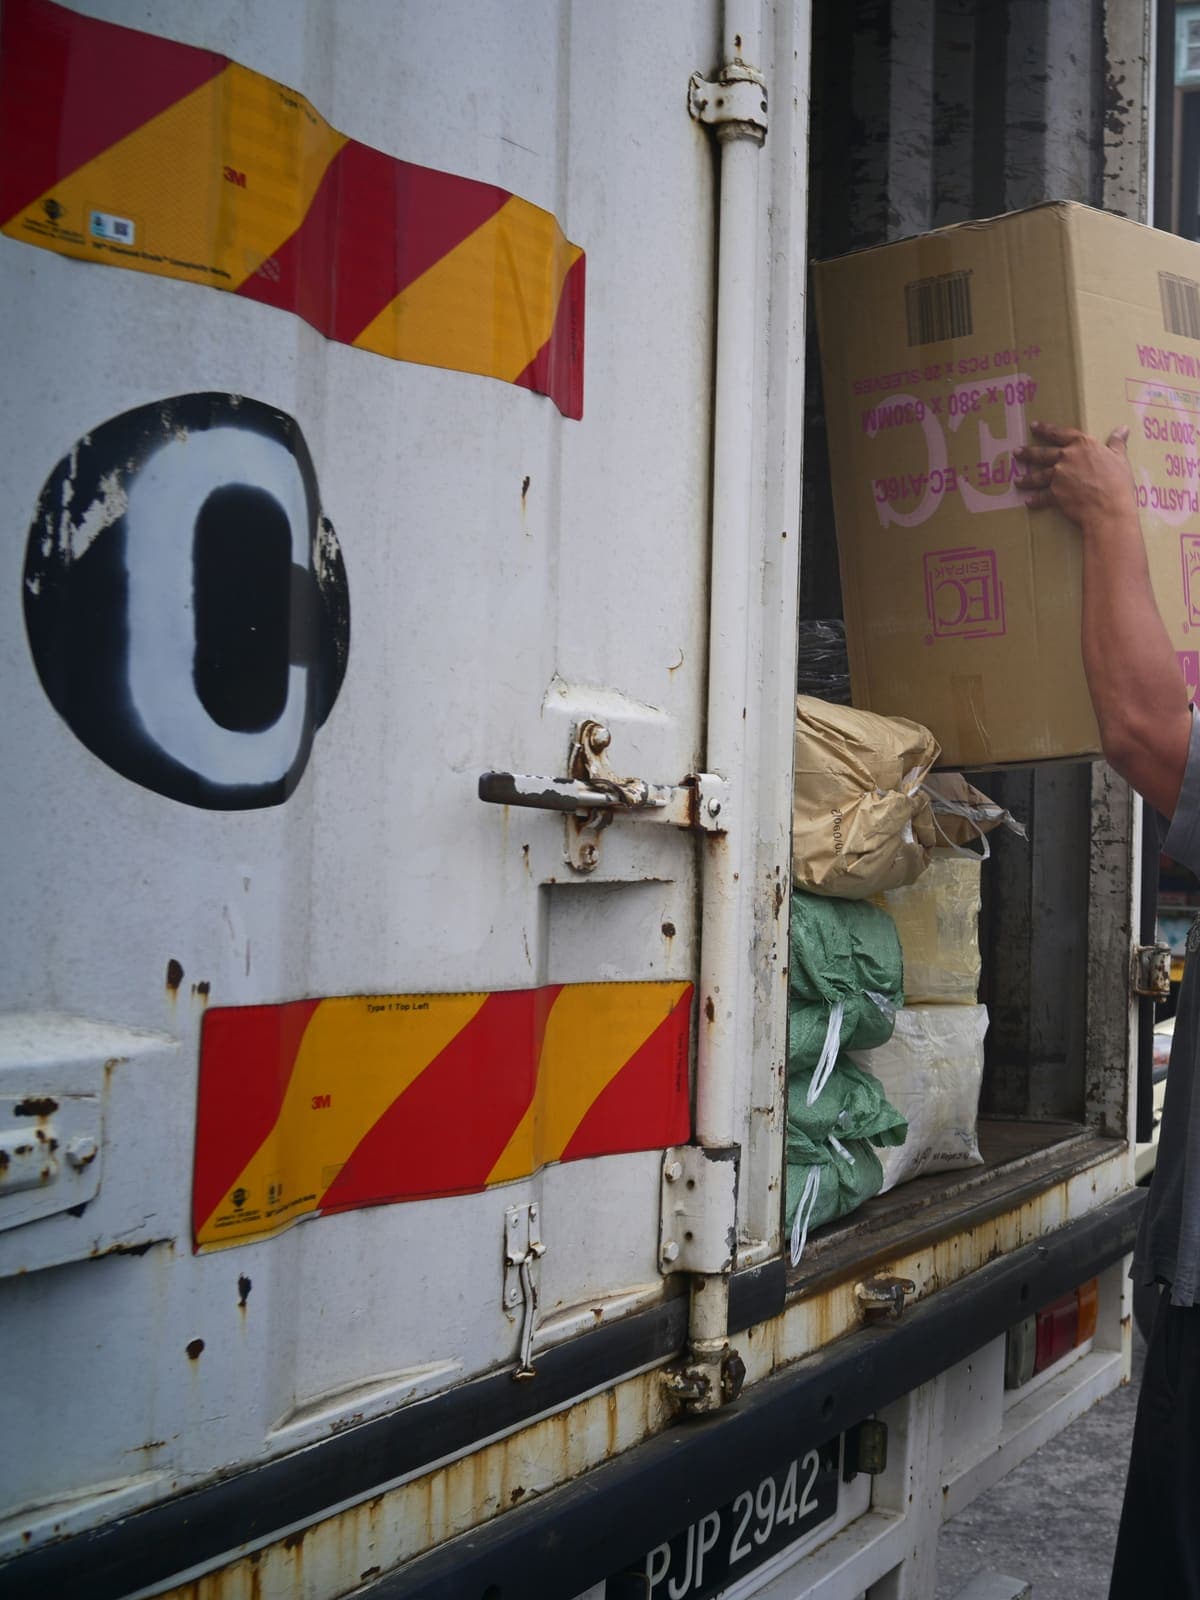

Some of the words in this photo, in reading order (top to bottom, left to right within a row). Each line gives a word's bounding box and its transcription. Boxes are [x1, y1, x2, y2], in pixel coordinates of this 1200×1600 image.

[224, 166, 247, 188] 3M
[958, 355, 990, 376] PCS
[1137, 345, 1195, 379] MALAYSIA
[948, 389, 981, 417] 380
[861, 400, 926, 433] 630MM
[1143, 416, 1168, 441] PCS
[1171, 421, 1195, 446] 2000
[873, 467, 958, 504] EC-A16C
[1150, 486, 1199, 513] PLASTIC
[932, 560, 991, 578] ESIPAK
[935, 574, 993, 627] EC
[396, 1003, 410, 1012] Top
[412, 1002, 430, 1010] Left
[311, 1094, 331, 1110] 3M
[646, 1511, 721, 1600] PJP
[729, 1448, 820, 1566] 2942
